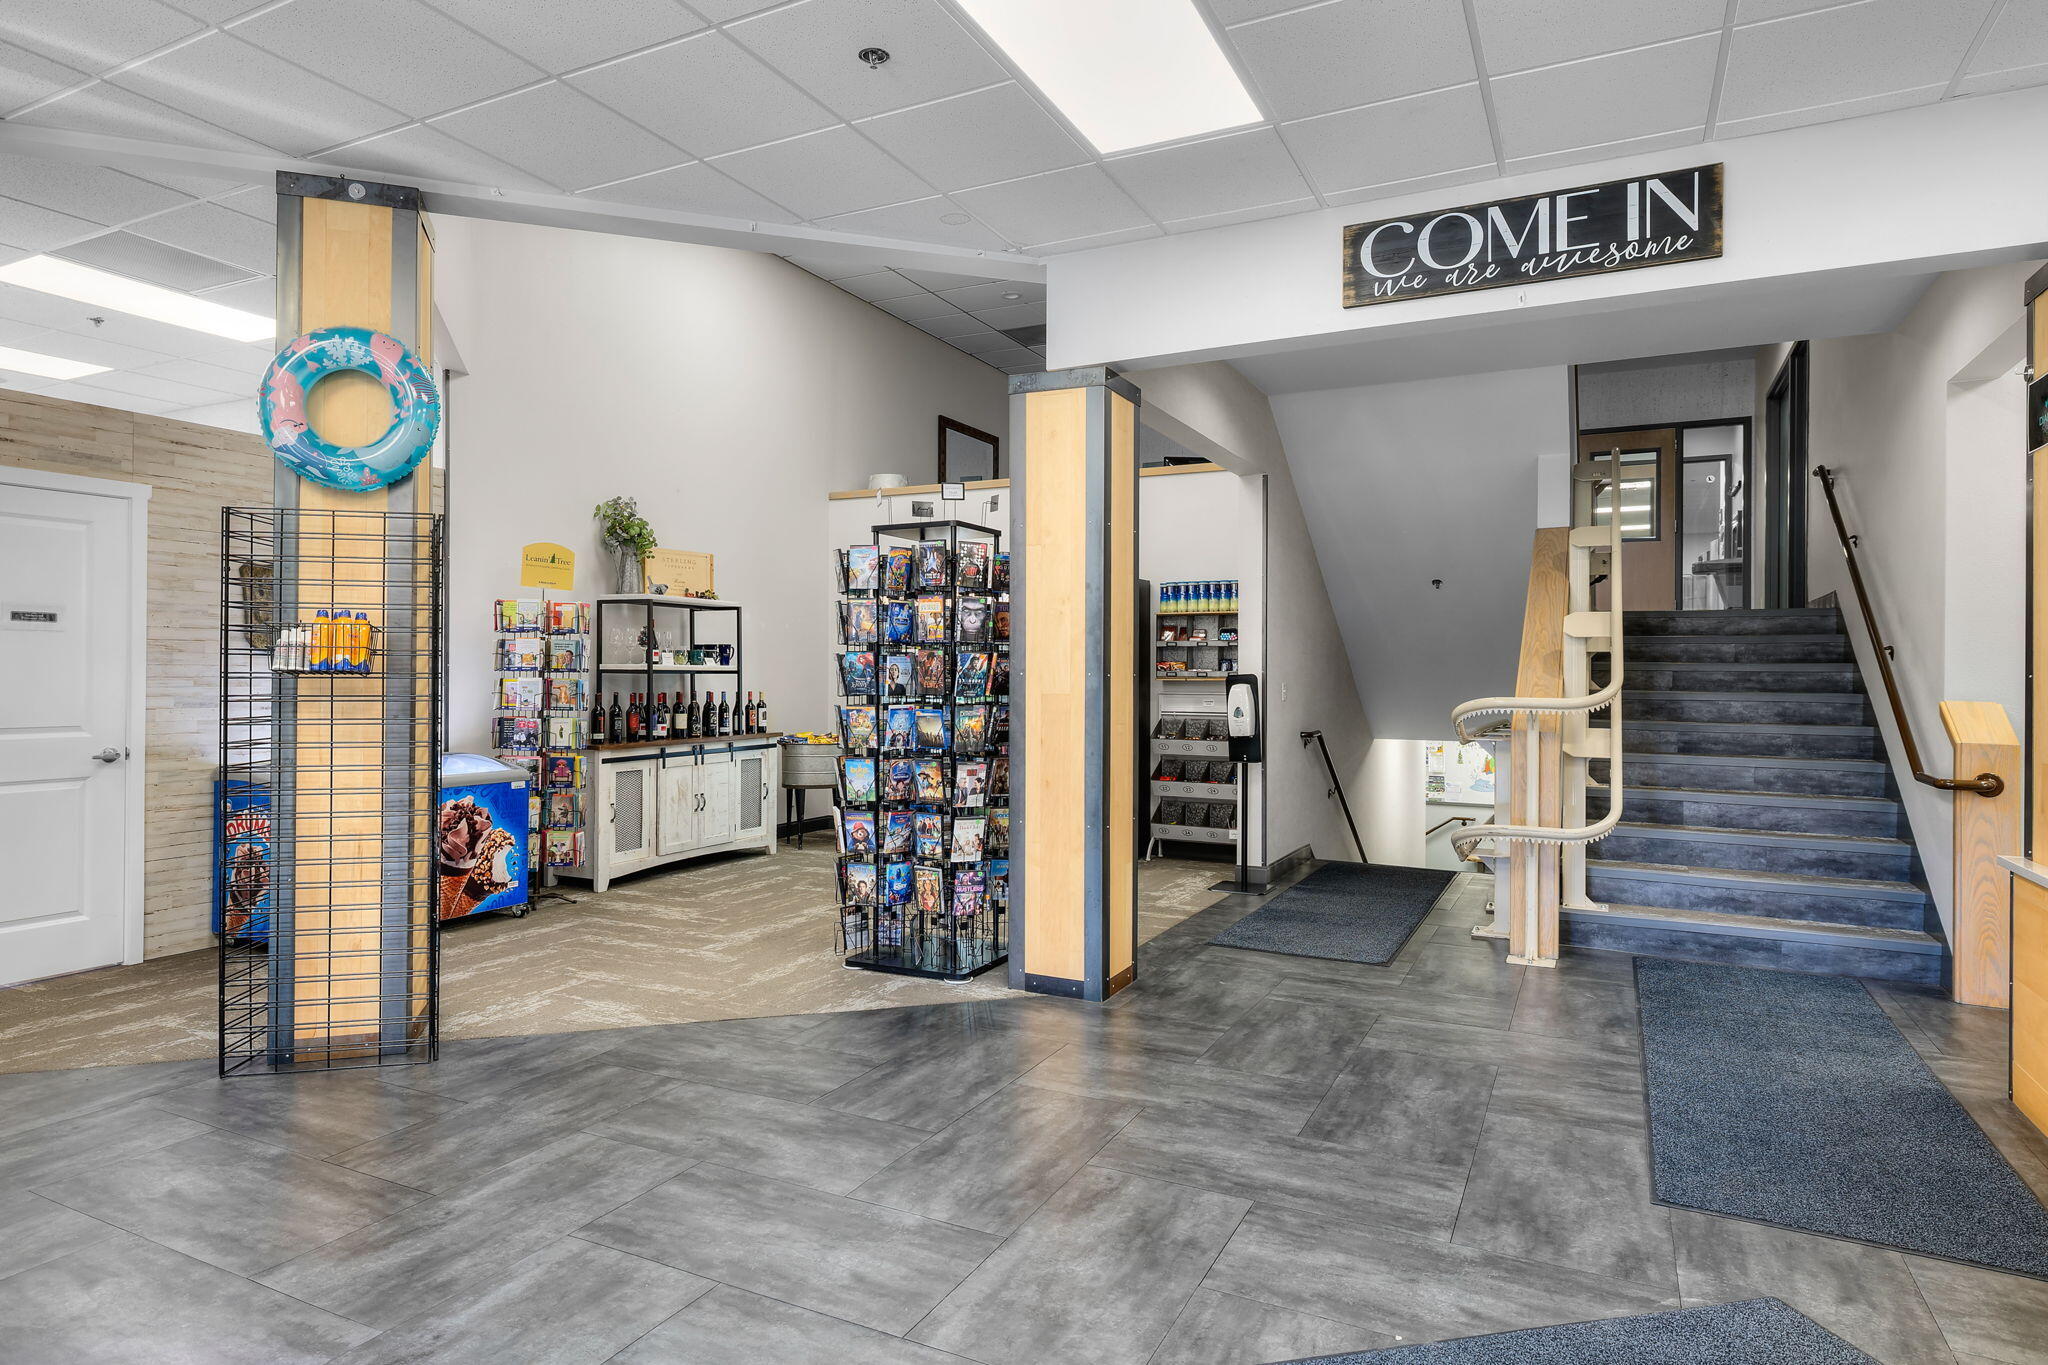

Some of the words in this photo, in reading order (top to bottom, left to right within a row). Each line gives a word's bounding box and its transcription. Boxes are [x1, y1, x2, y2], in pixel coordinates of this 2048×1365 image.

[1360, 188, 1600, 279] COME
[1627, 171, 1700, 242] IN
[1374, 273, 1428, 297] we
[1445, 262, 1501, 287] are
[1521, 234, 1694, 277] awesome
[555, 557, 572, 566] Tree
